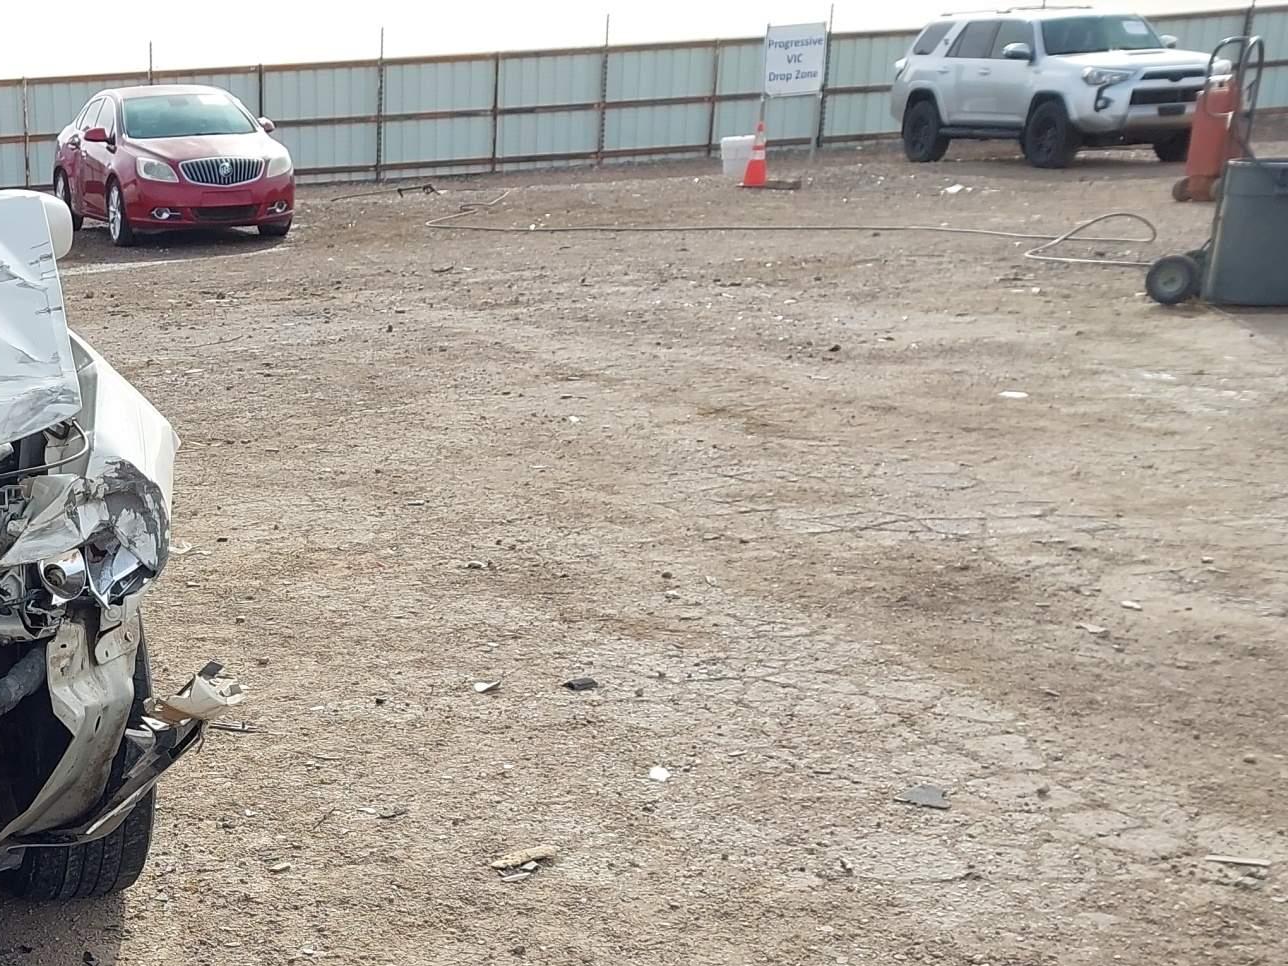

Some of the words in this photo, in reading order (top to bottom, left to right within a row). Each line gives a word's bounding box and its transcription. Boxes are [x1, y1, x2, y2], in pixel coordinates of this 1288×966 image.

[769, 37, 824, 50] Progressive
[787, 53, 803, 64] VIC
[769, 71, 792, 83] Drop
[795, 69, 818, 80] Zone
